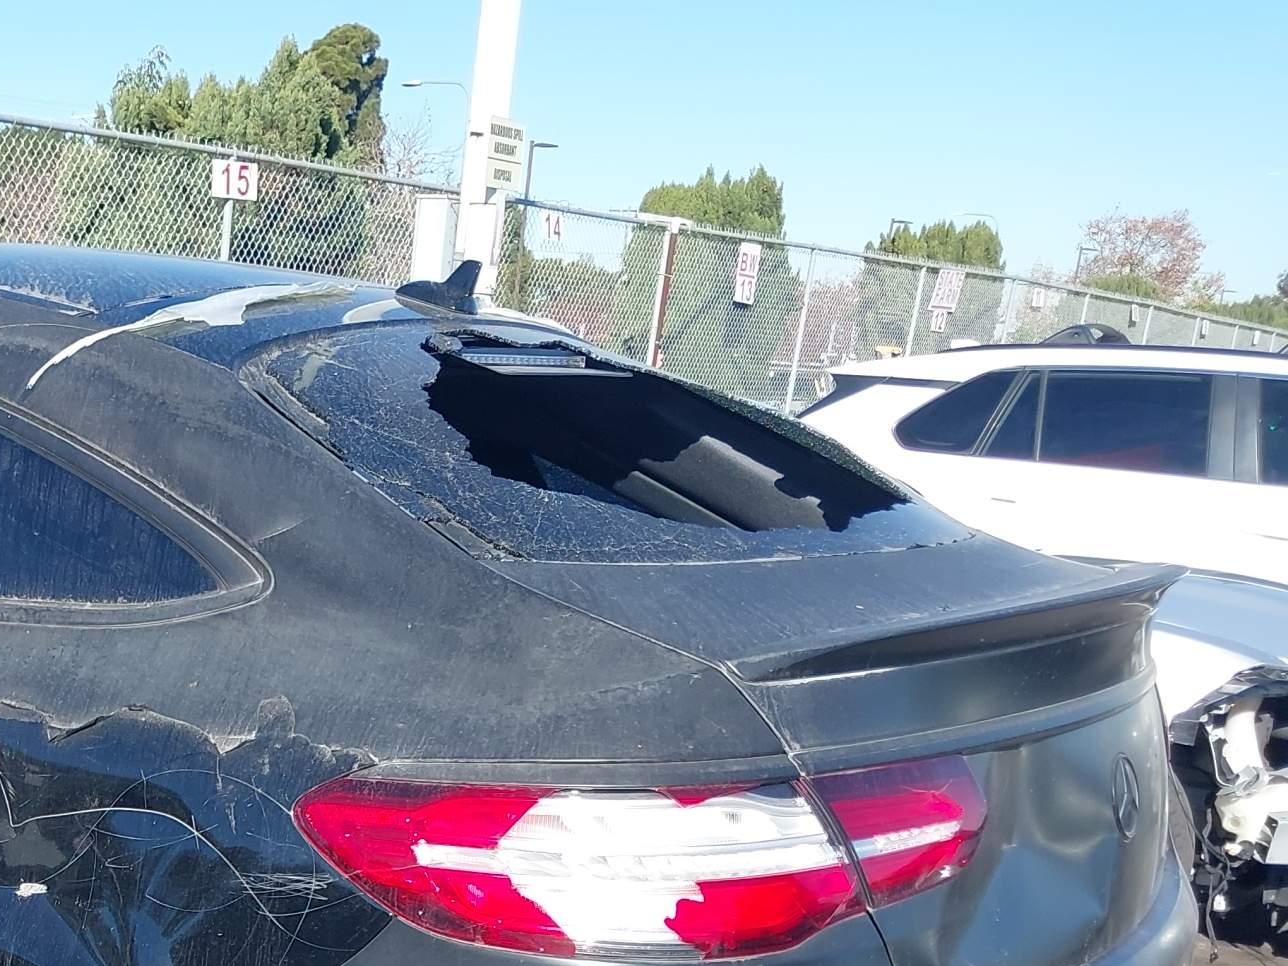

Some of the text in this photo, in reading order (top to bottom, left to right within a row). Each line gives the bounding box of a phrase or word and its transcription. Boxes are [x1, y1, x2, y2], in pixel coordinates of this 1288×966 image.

[222, 163, 250, 196] 15
[545, 213, 561, 240] 14
[740, 278, 753, 302] 13
[938, 270, 964, 289] STATE
[933, 287, 959, 305] FARM
